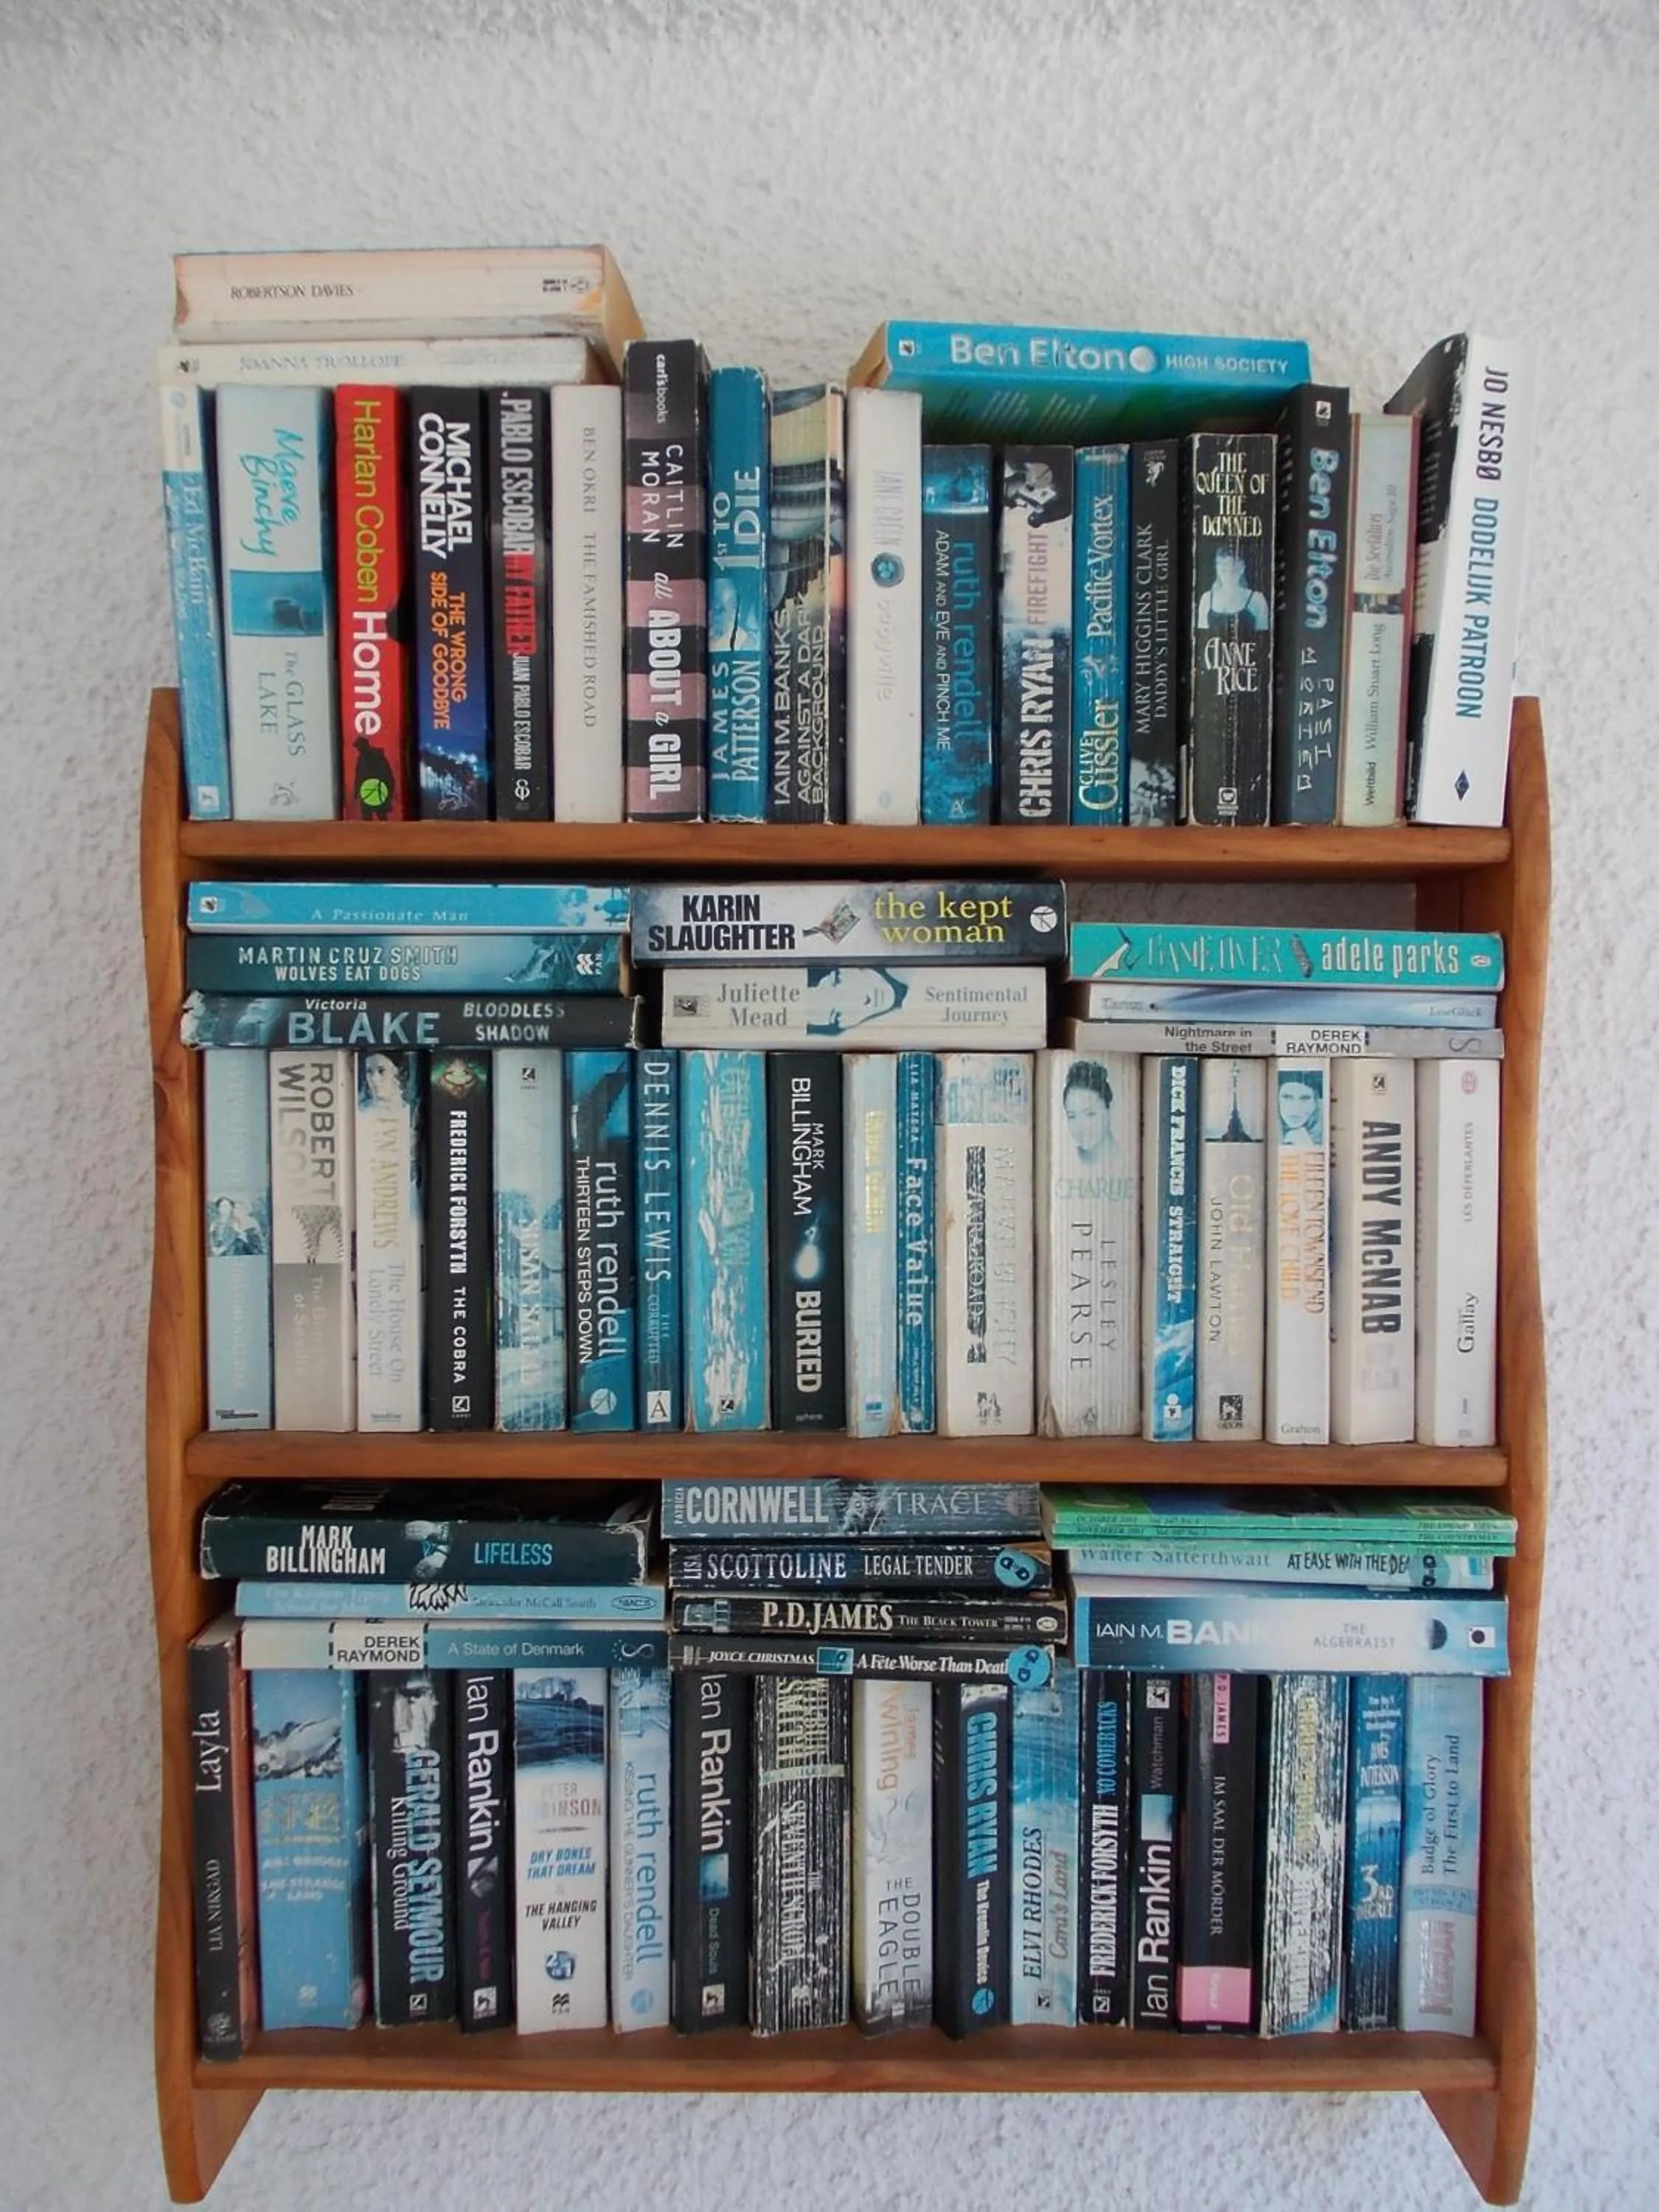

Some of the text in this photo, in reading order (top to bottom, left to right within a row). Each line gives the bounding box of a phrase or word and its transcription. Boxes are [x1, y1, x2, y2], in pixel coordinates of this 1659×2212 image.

[230, 285, 354, 299] ROBERTSON DAVIES
[950, 334, 1124, 368] Ben Elton
[1166, 355, 1288, 375] HIGH SOCIETY
[1217, 452, 1248, 473] THE
[418, 412, 447, 560] CONNELLY
[445, 422, 472, 551] MICHAEL
[641, 452, 660, 543] MORAN
[666, 445, 684, 549] CAITLIN
[1197, 471, 1270, 495] QUEEN OF
[1218, 495, 1248, 516] THE
[1203, 516, 1263, 537] DAMNED
[1455, 366, 1509, 720] JO NESBØ DODELIJK PATROON
[352, 400, 387, 735] Harlan Coben Home
[582, 427, 597, 728] BEN OKRI THE FAMISHED ROAD
[449, 591, 467, 702] THE WRONG
[953, 543, 977, 744] ruth rendell
[1134, 524, 1153, 736] MARY HIGGINS CLARK
[1154, 540, 1169, 719] DADDY'S LITTLE GIRL
[431, 572, 449, 730] SIDE OF GOODBYE
[1204, 638, 1256, 669] ANNE
[1216, 668, 1258, 696] RICE
[257, 670, 278, 734] LAKE
[1365, 624, 1386, 807] Weltbild William Stuart Long
[682, 894, 760, 922] KARIN
[874, 891, 1012, 928] the kept
[648, 924, 796, 952] SLAUGHTER
[881, 926, 1004, 944] woman
[238, 946, 459, 964] MARTIN CRUZ SMITH
[1321, 937, 1460, 978] adele parks
[275, 967, 420, 981] WOLVES EAT DOGS
[305, 998, 368, 1012] Victoria
[463, 1002, 565, 1019] BLOODLESS
[717, 983, 801, 1004] Juliette
[925, 987, 1028, 1004] Sentimental
[288, 1012, 441, 1045] BLAKE
[475, 1025, 549, 1041] SHADOW
[731, 1007, 788, 1027] Mead
[942, 1007, 1010, 1025] Journey
[1164, 1026, 1252, 1040] Nightmare in
[1185, 1040, 1253, 1054] the Street
[1286, 1042, 1362, 1054] RAYMOND
[1310, 1029, 1362, 1041] DEREK
[310, 1062, 336, 1202] ROBERT
[791, 1077, 813, 1217] BILLINGHAM
[811, 1123, 826, 1170] MARK
[643, 1062, 670, 1282] DENNIS LEWIS
[1361, 1120, 1402, 1206] ANDY
[449, 1110, 467, 1383] FREDERICK FORSYTH THE COBRA
[576, 1155, 594, 1365] THIRTEEN STEPS DOWN
[595, 1161, 627, 1357] ruth rendell
[1208, 1197, 1223, 1343] JOHN LAWTON
[1069, 1222, 1093, 1371] PEARSE
[1100, 1239, 1116, 1352] LESLEY
[368, 1268, 386, 1376] Lonely Street
[388, 1263, 406, 1383] The House On
[647, 1294, 658, 1364] CORRUPTED
[1457, 1292, 1478, 1354] Gallay
[796, 1290, 823, 1393] BURIED
[674, 1487, 684, 1523] PATRICIA
[686, 1485, 830, 1524] CORNWELL
[893, 1492, 987, 1514] TRACE
[300, 1525, 353, 1550] MARK
[474, 1543, 552, 1566] LIFELESS
[266, 1547, 386, 1575] BILLINGHAM
[684, 1554, 702, 1579] LISA
[707, 1552, 847, 1580] SCOTTOLINE
[864, 1555, 973, 1576] LEGAL TENDER
[365, 1635, 420, 1648] DEREK
[1312, 1636, 1397, 1649] ALGEBRAIST
[1343, 1624, 1367, 1635] THE
[337, 1649, 420, 1662] RAYMOND
[448, 1642, 584, 1655] A State of Denmark
[193, 1710, 229, 1794] Layla
[466, 1676, 501, 1852] Ian Rankin
[700, 1672, 732, 1851] Ian Rankin
[1150, 1717, 1164, 1790] Watchman
[1422, 1753, 1441, 1874] Badge of Glory
[386, 1797, 408, 1931] Killing Ground
[406, 1750, 445, 1985] GERALD SEYMOUR
[526, 1863, 596, 1880] THAT DREAM
[531, 1848, 592, 1865] DRY BONES
[636, 1773, 665, 1964] ruth rendell
[1208, 1775, 1226, 1936] IM SAAL DER MÖRDER
[526, 1900, 597, 1917] THE HANGING
[1023, 1827, 1043, 1980] ELVI RHODES
[540, 1916, 580, 1931] VALLEY
[1138, 1844, 1172, 2019] Ian Rankin
